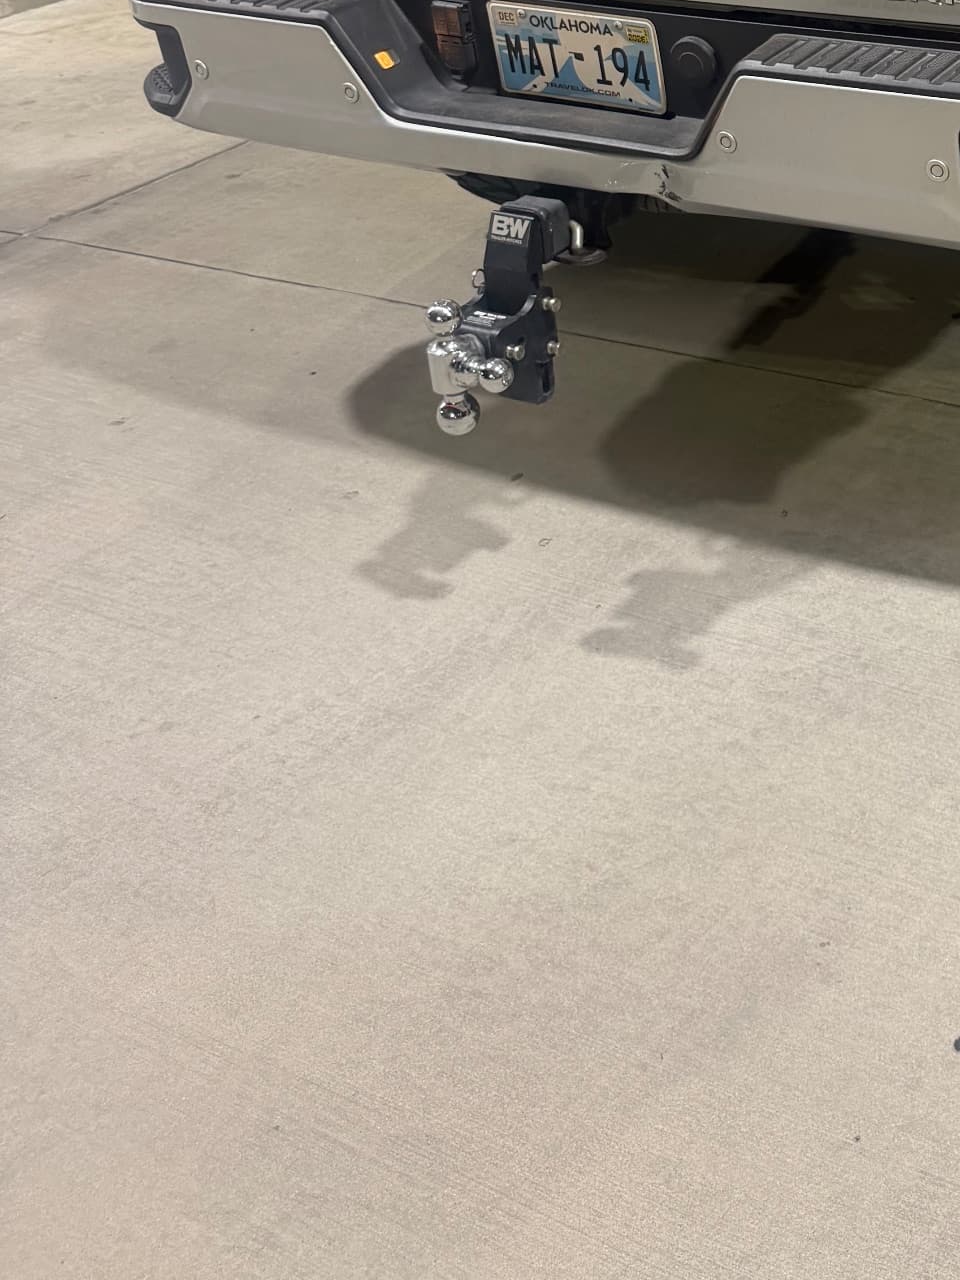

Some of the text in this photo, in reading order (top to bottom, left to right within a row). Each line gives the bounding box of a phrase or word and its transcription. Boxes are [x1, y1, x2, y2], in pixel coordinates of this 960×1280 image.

[498, 11, 515, 22] DEC
[529, 14, 614, 37] OKLAHOMA
[544, 81, 621, 97] TRAVELOK.COM
